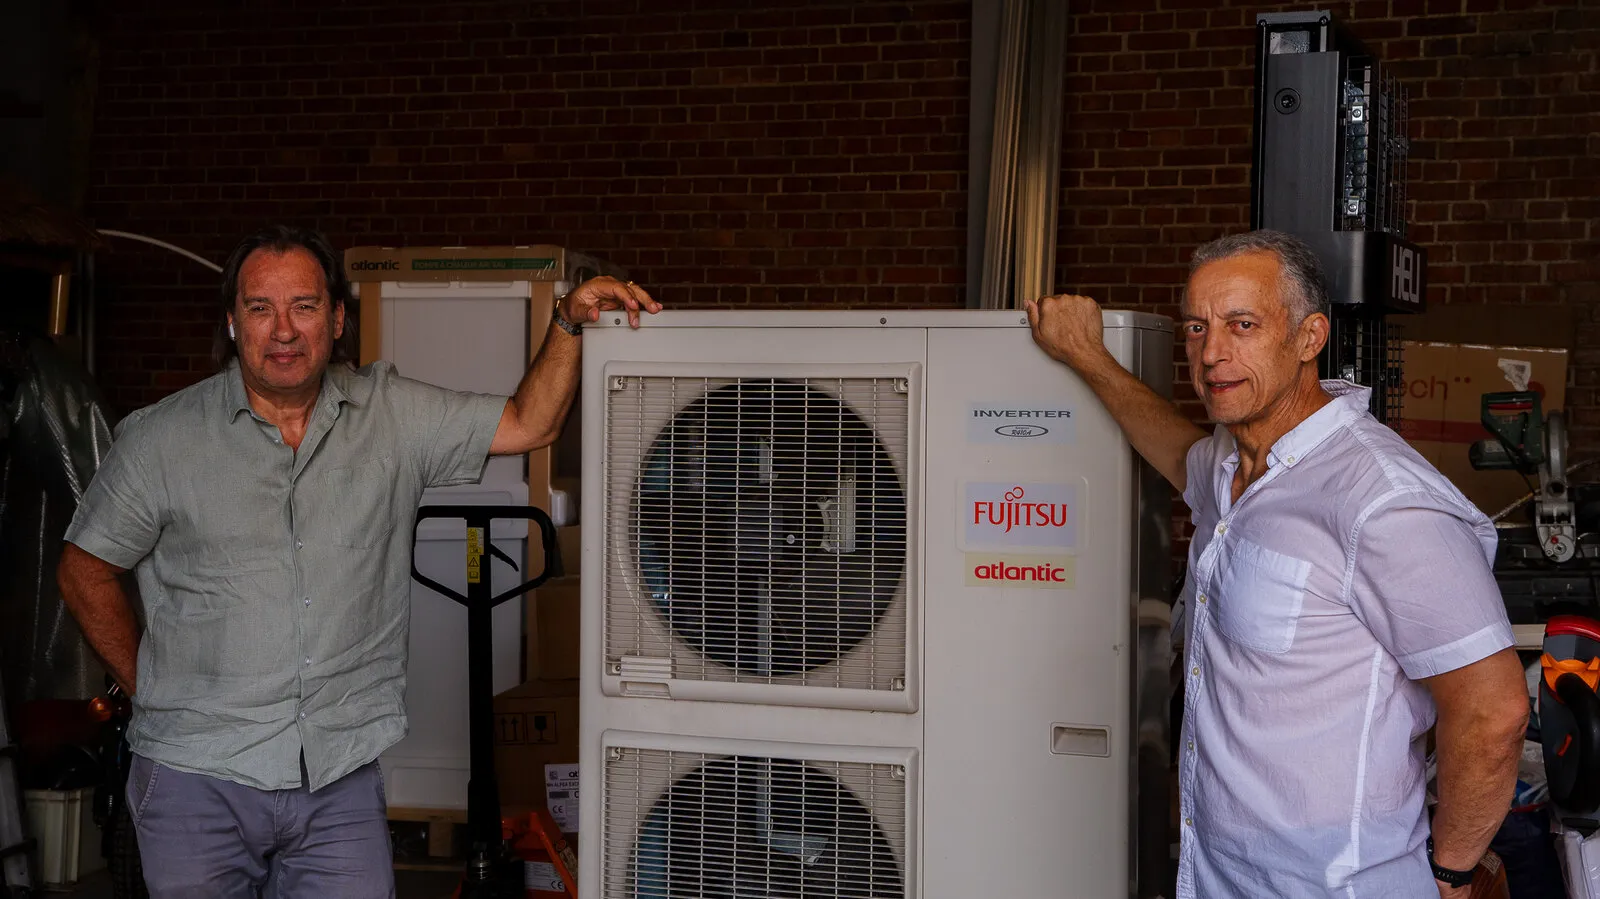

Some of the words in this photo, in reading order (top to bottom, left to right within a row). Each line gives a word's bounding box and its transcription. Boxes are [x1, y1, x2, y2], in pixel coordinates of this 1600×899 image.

[351, 259, 400, 271] atlantic
[1391, 243, 1420, 304] HELI
[1397, 375, 1448, 400] ech
[973, 410, 1071, 418] INVERTER
[974, 501, 1068, 533] FUJITSU
[974, 561, 1066, 582] atlantic
